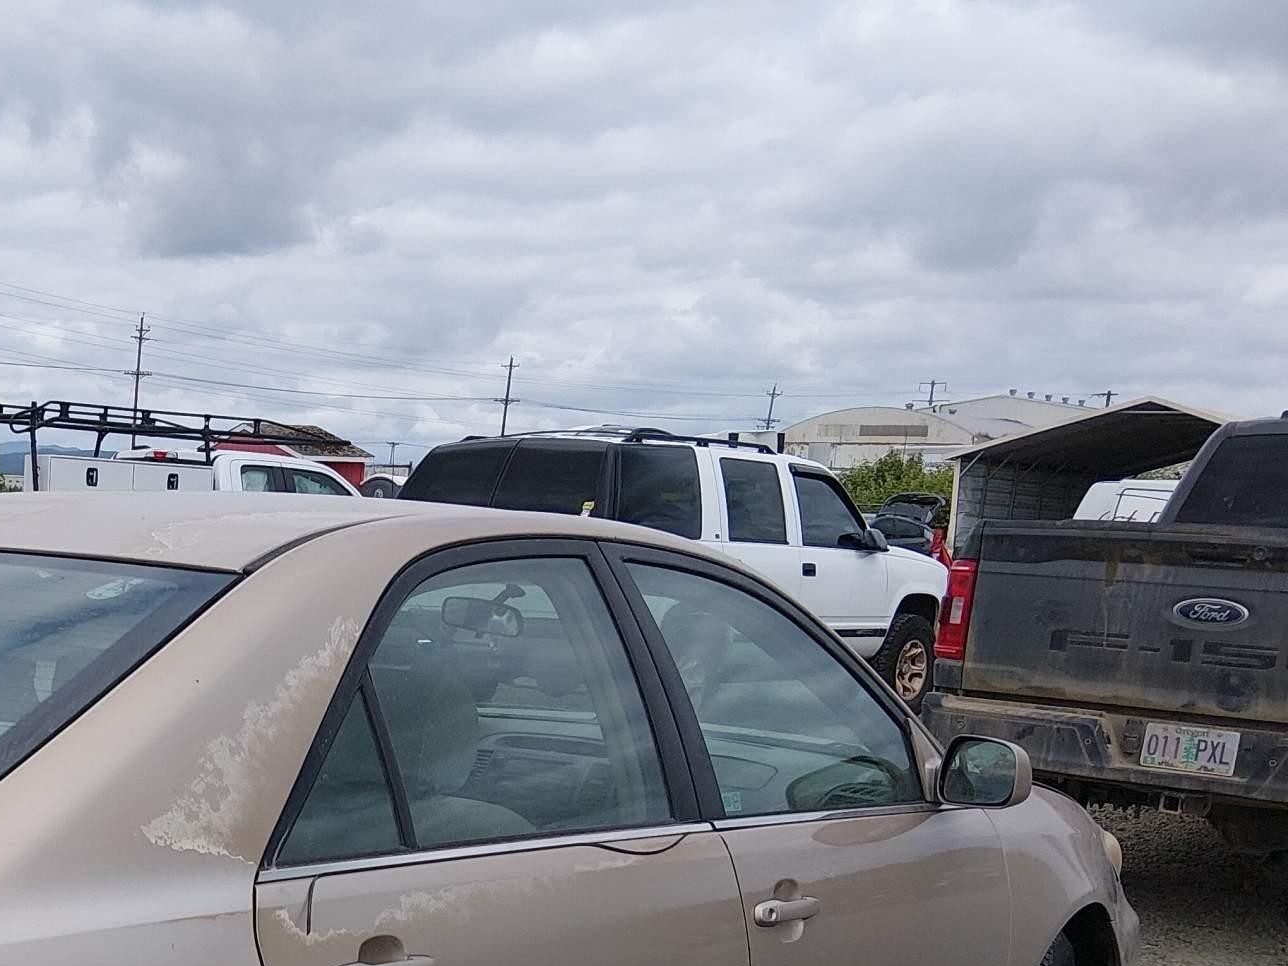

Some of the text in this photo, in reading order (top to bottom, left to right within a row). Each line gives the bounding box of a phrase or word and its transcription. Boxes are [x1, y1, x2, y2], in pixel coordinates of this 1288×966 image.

[1189, 603, 1231, 622] Ford
[1049, 629, 1288, 671] F-15
[1147, 733, 1230, 766] 011 PXL
